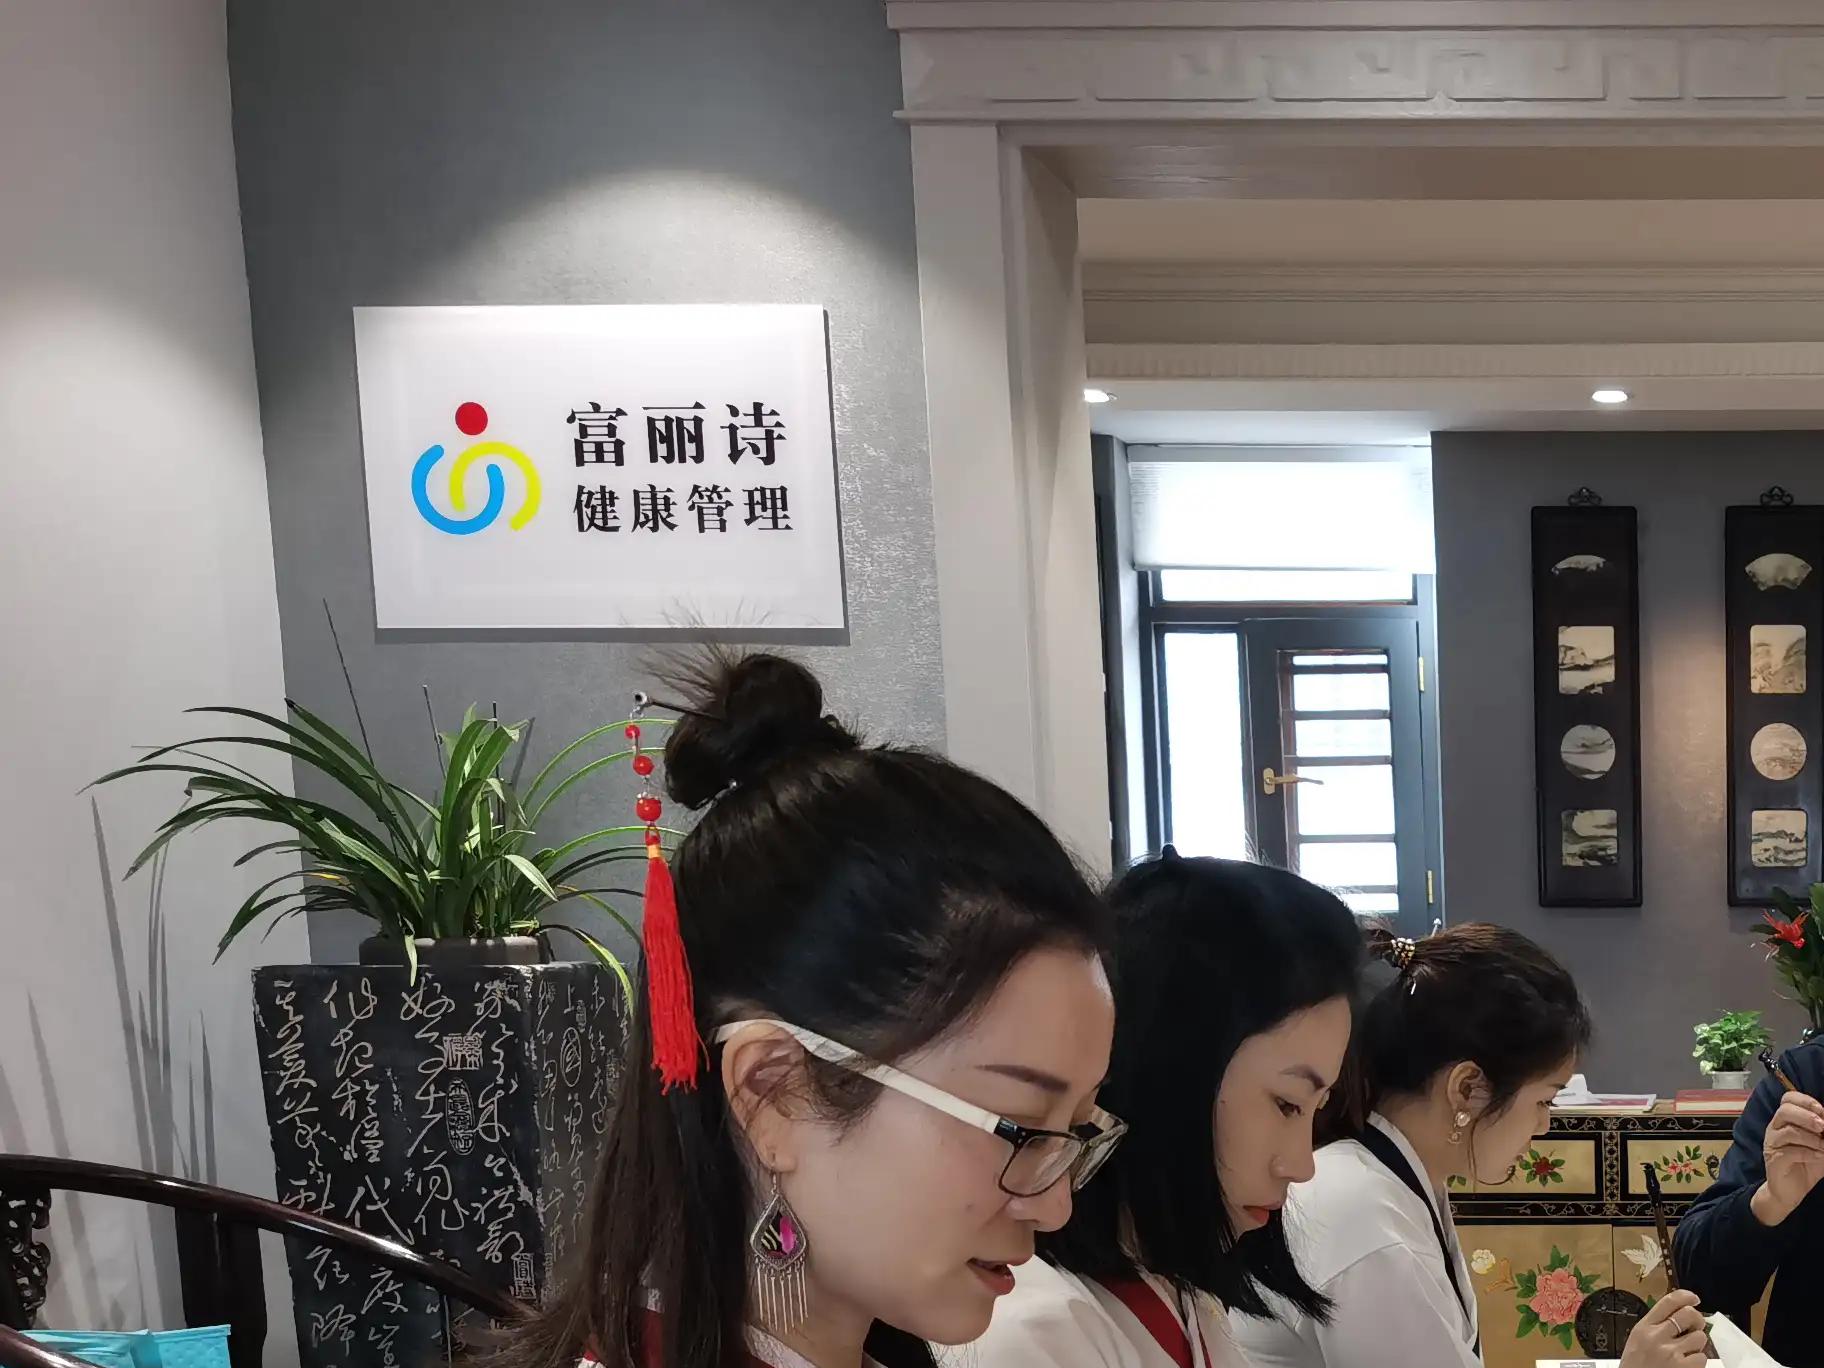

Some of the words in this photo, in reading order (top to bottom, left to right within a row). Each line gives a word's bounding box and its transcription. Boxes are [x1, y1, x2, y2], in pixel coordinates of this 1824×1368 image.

[566, 401, 786, 468] 富丽诗
[573, 483, 793, 534] 健康管理
